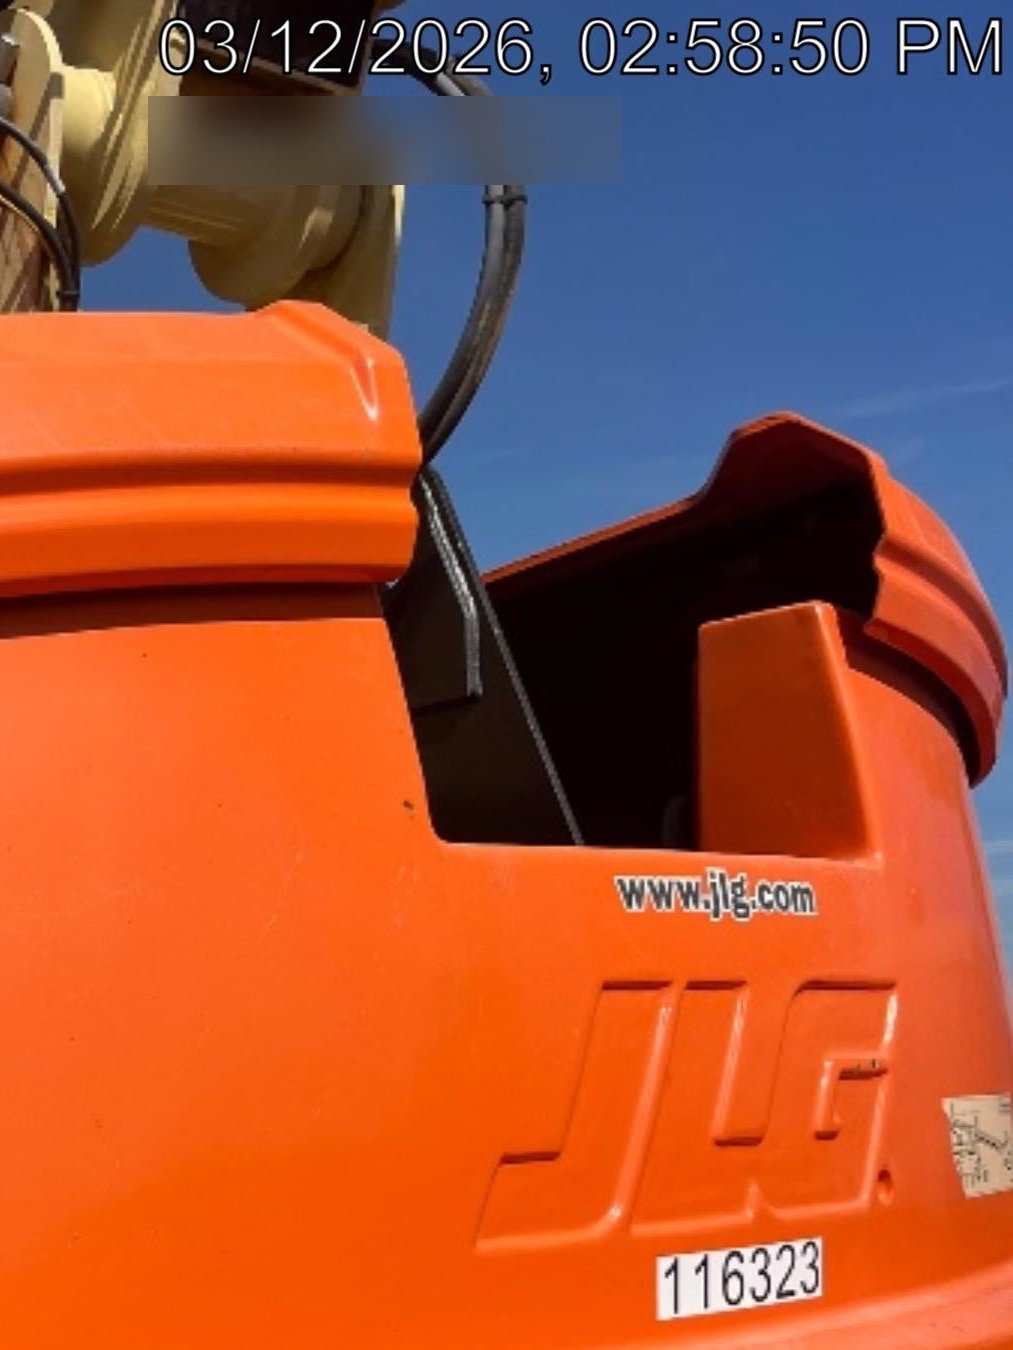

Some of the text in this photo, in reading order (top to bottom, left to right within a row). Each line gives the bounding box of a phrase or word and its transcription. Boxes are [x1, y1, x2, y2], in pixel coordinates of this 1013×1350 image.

[615, 869, 815, 919] www.jlg.com
[475, 979, 897, 1254] JLG
[663, 1240, 820, 1315] 116323
